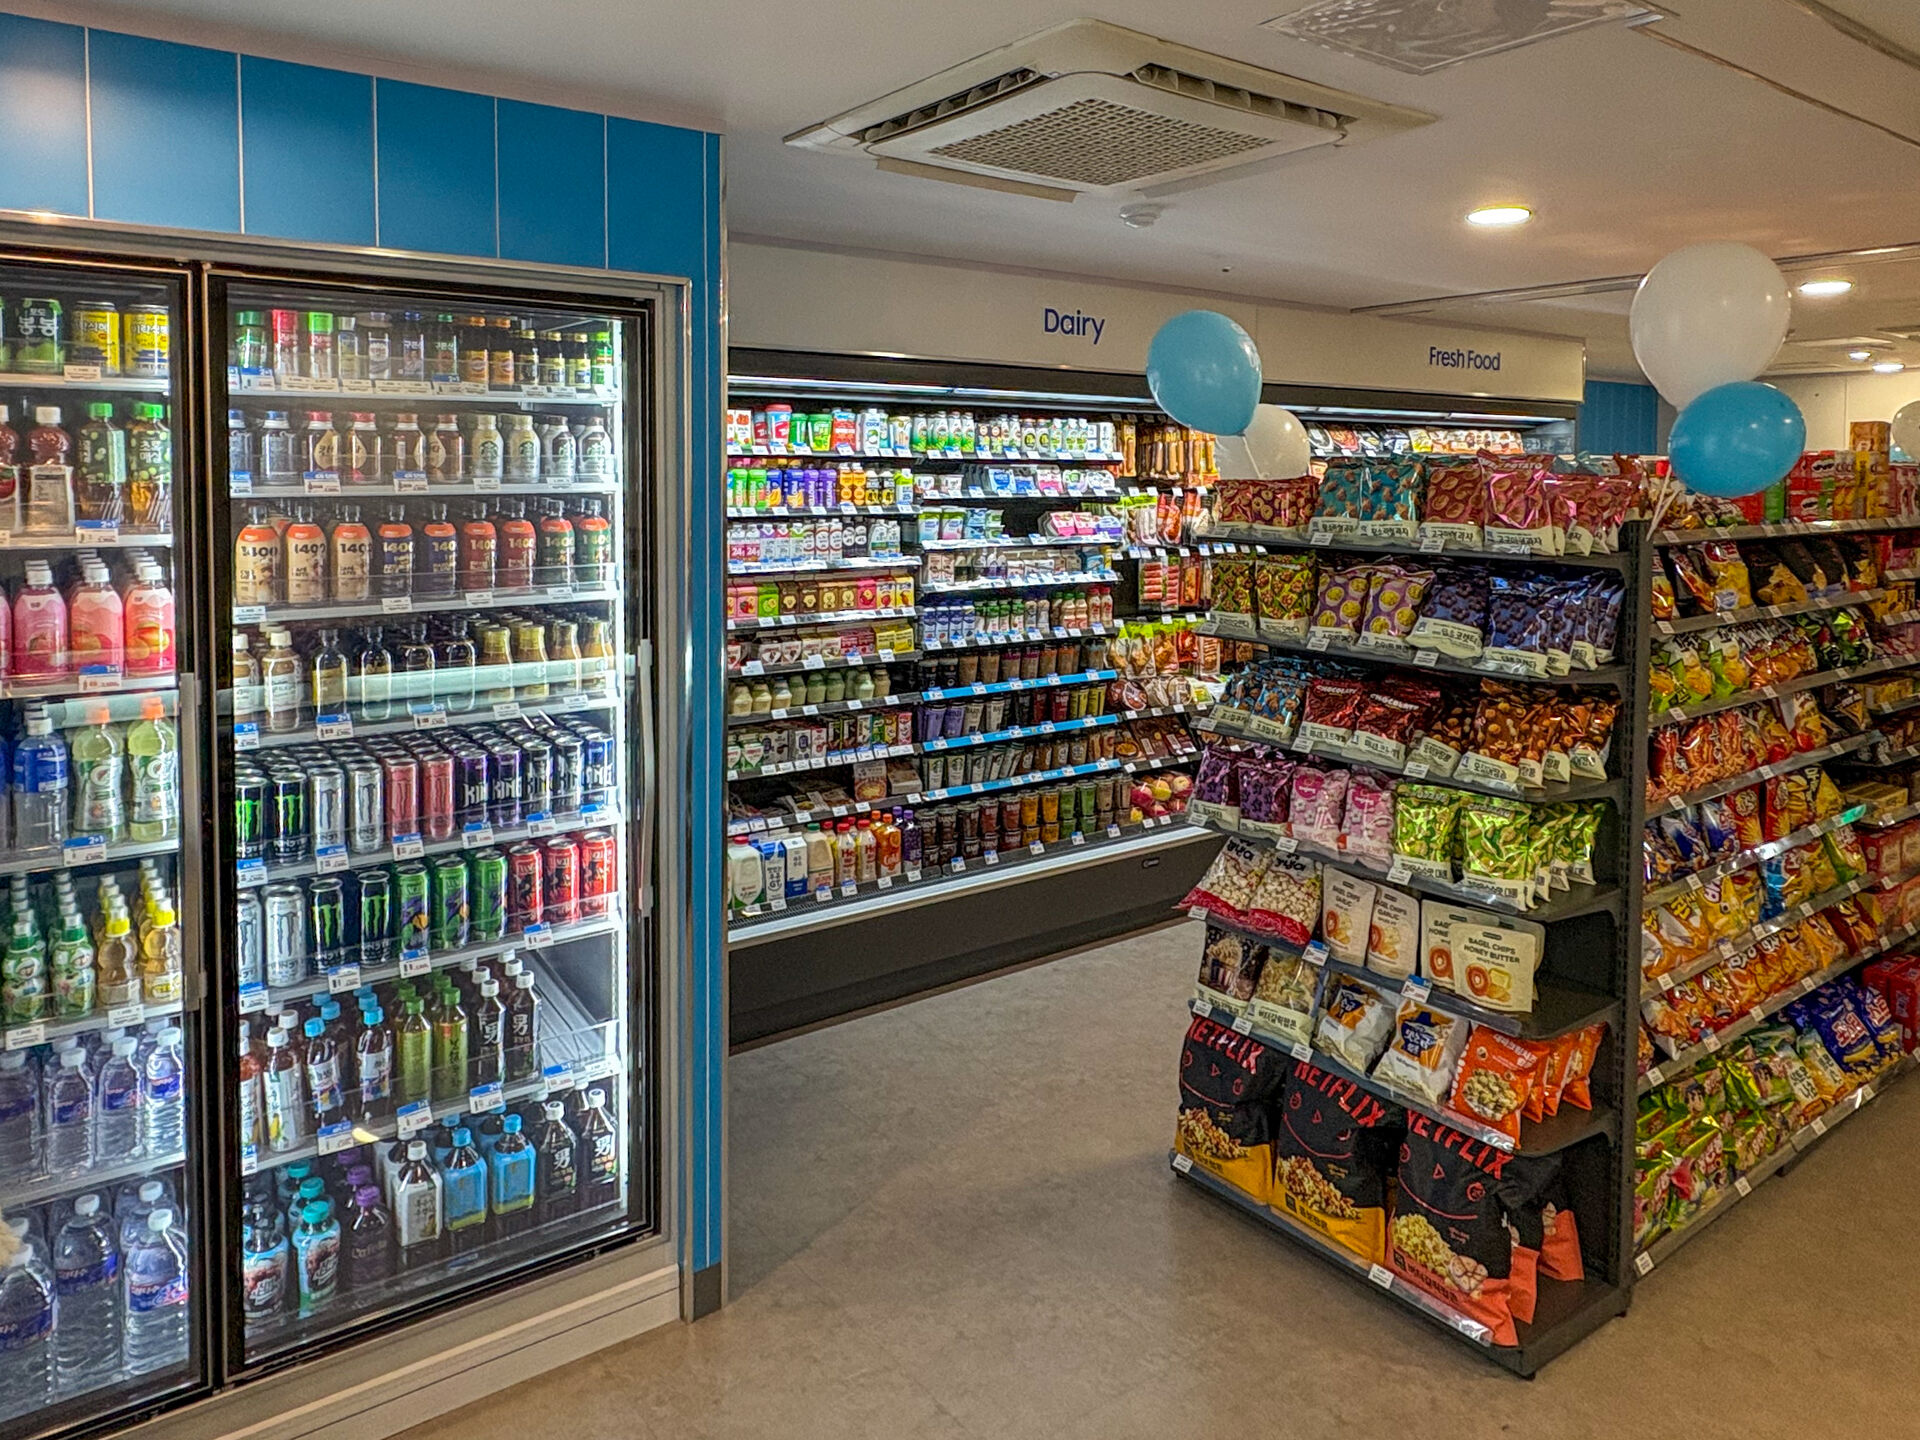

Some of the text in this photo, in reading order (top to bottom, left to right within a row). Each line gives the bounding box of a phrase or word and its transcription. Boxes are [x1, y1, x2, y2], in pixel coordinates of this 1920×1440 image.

[17, 316, 59, 338] 봉봉
[1044, 308, 1106, 345] Dairy
[1429, 346, 1501, 371] Fresh Food
[1377, 908, 1401, 921] GARLIC
[1428, 927, 1449, 939] HONE
[1463, 944, 1521, 964] HONEY BUTTER
[1468, 937, 1517, 956] BAGEL CHIPS
[511, 1014, 529, 1036] 男
[1293, 1061, 1386, 1128] NETFLIX
[594, 1134, 611, 1157] 男
[1407, 1109, 1515, 1180] NETFLIX
[553, 1148, 571, 1169] 男
